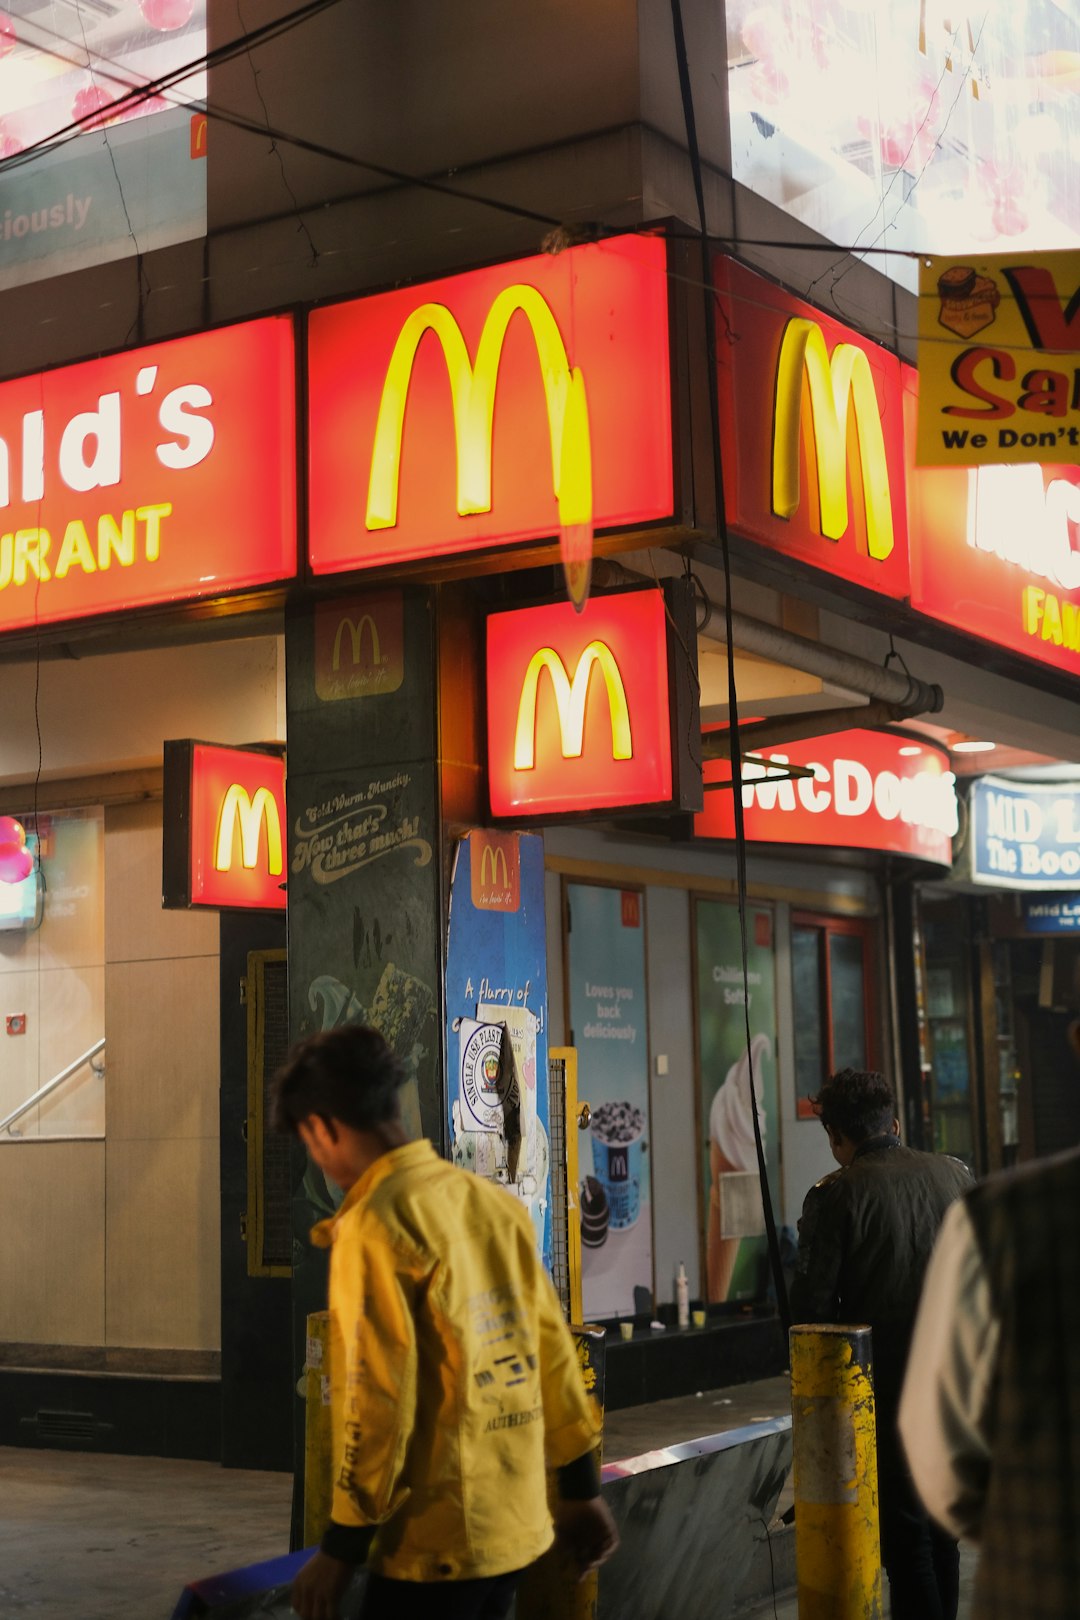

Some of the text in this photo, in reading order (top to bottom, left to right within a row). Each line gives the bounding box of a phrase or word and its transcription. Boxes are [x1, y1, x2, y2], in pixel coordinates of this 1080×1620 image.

[0, 192, 92, 241] iously
[942, 426, 1079, 449] We Don't
[986, 791, 1041, 843] MID
[291, 834, 333, 874] Now
[987, 838, 1080, 875] The Boo
[465, 977, 473, 999] A
[517, 980, 531, 1008] of
[585, 982, 634, 1005] Loves you
[597, 1003, 622, 1019] back
[583, 1023, 637, 1043] deliciously
[468, 1039, 481, 1061] USE
[465, 1062, 479, 1107] SINGLE
